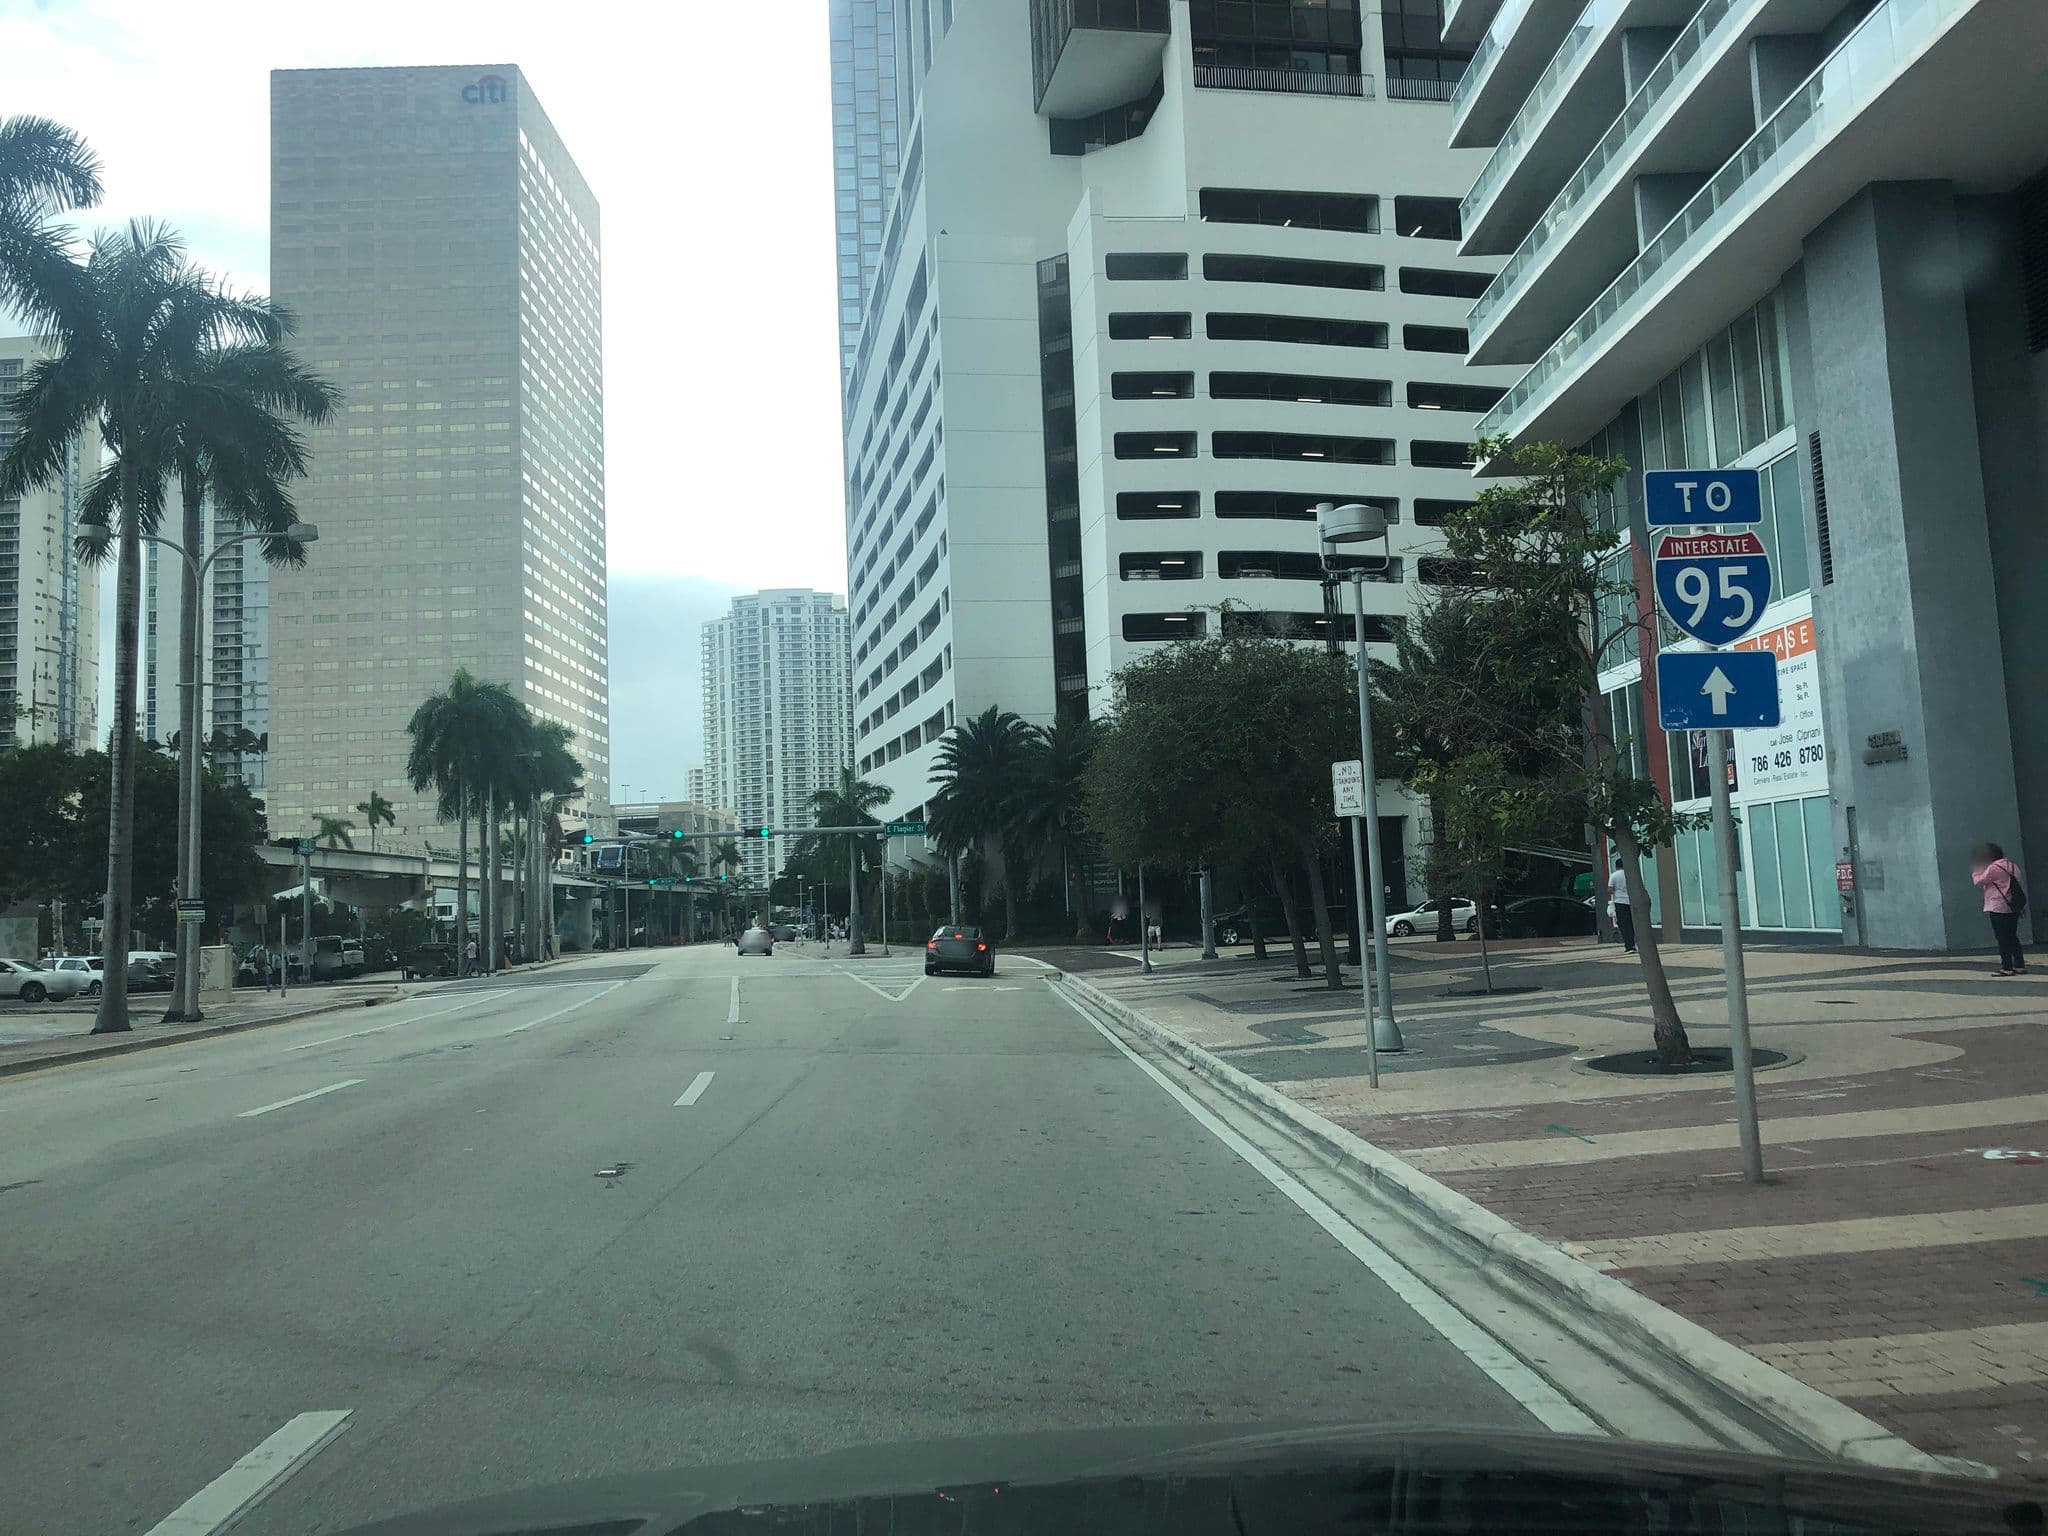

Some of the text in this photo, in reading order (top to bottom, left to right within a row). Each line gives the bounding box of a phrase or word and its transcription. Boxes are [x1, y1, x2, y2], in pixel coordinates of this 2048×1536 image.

[462, 75, 506, 104] citi
[1674, 481, 1731, 513] TO
[1670, 538, 1750, 556] INTERSTATE
[1675, 566, 1754, 628] 95
[1779, 734, 1793, 745] Jose
[1796, 727, 1821, 742] Cipriani
[1751, 754, 1769, 773] 786
[1774, 750, 1791, 768] 426
[1799, 743, 1823, 764] 8780
[1341, 766, 1352, 775] NO
[893, 825, 914, 833] Flagler
